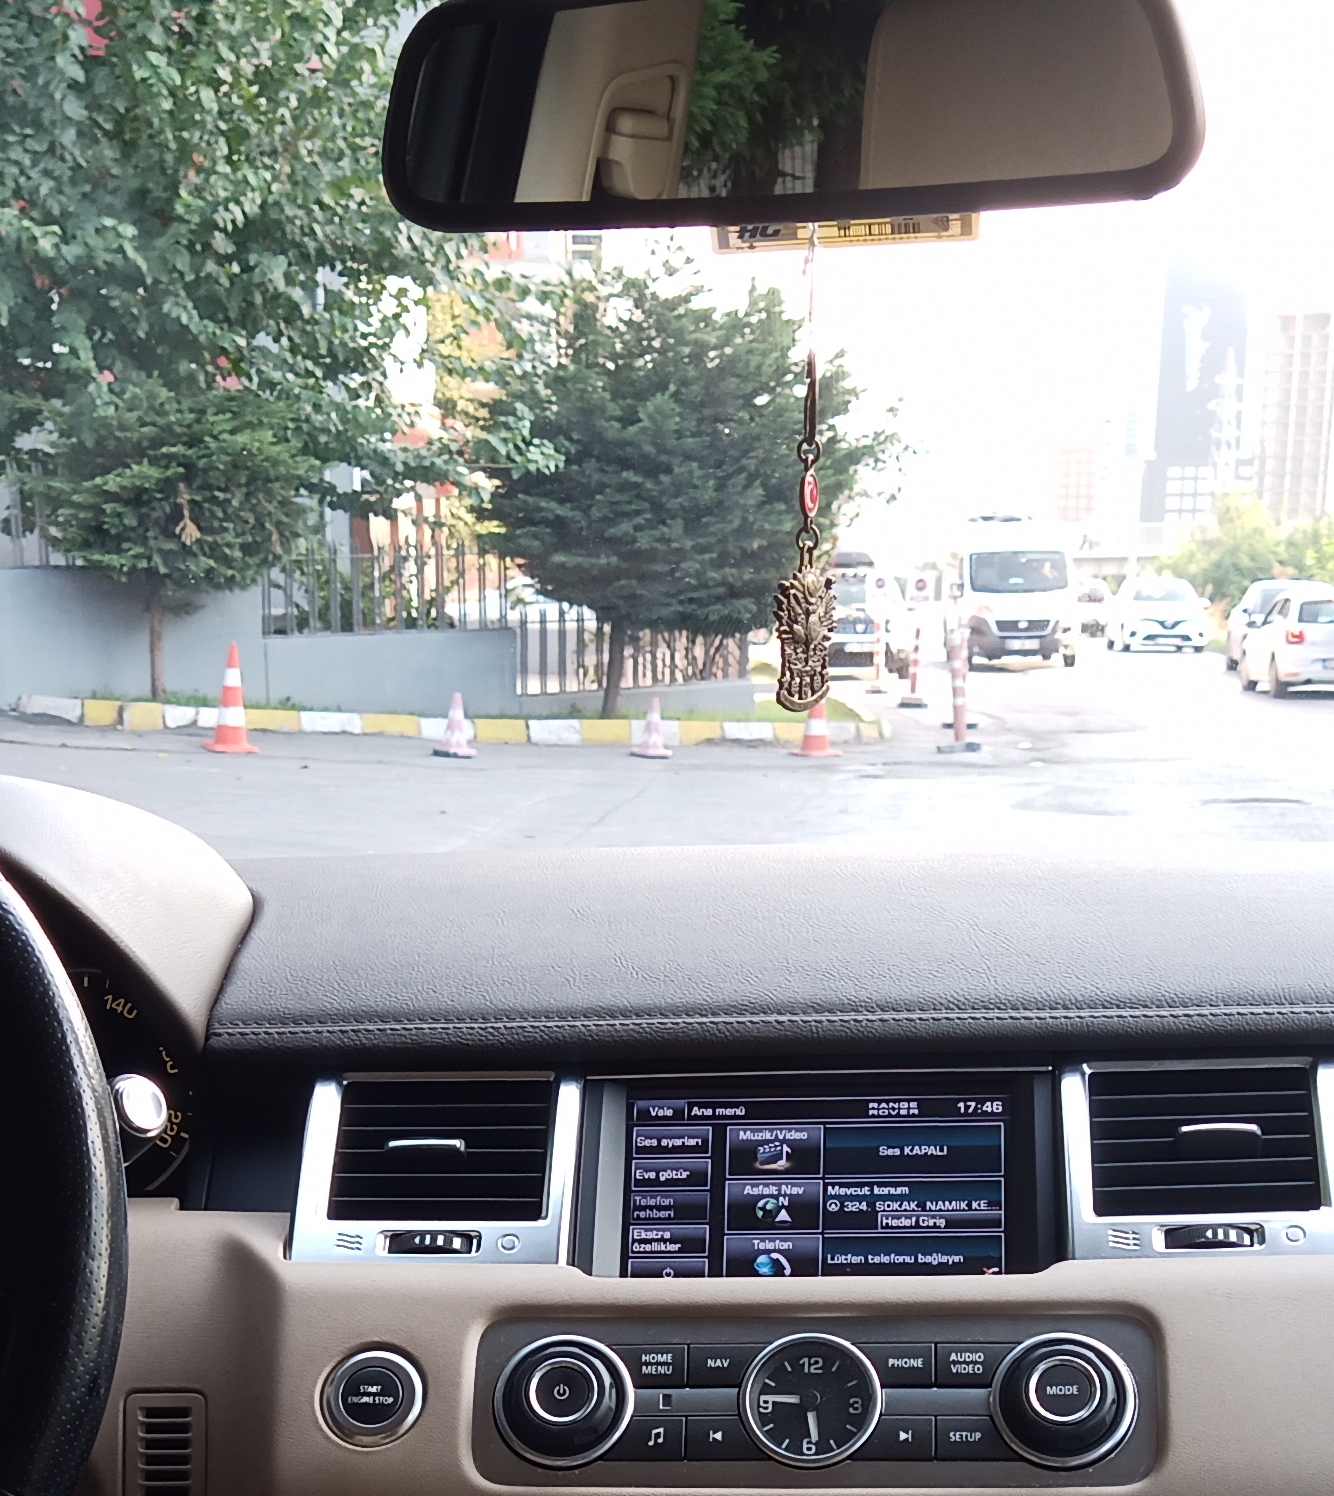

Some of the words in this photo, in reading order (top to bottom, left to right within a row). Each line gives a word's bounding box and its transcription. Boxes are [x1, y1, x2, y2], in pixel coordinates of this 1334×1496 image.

[649, 1107, 673, 1117] Vale
[691, 1106, 713, 1116] Ana
[716, 1105, 746, 1116] menü
[957, 1101, 1003, 1114] 17:46
[739, 1130, 808, 1141] Muzik/Video
[637, 1137, 658, 1147] Ses
[661, 1136, 702, 1148] ayarları
[879, 1146, 901, 1156] Ses
[904, 1145, 948, 1156] KAPALI
[636, 1169, 656, 1179] Eve
[659, 1168, 690, 1181] götür
[744, 1184, 778, 1196] Asfalt
[781, 1184, 805, 1195] Nav
[827, 1185, 871, 1196] Mevcut
[874, 1185, 909, 1195] konum
[634, 1196, 674, 1206] Telefon
[926, 1200, 969, 1211] NAMIK
[633, 1209, 674, 1219] rehberi
[882, 1216, 916, 1227] Hedef
[919, 1216, 946, 1228] Giriş
[633, 1230, 671, 1239] Ekstra
[632, 1241, 682, 1252] özellikler
[752, 1240, 793, 1250] Telefon
[827, 1253, 865, 1264] Lütfen
[868, 1253, 915, 1264] telefonu
[918, 1253, 964, 1266] bağlayın
[641, 1353, 673, 1363] HOME
[707, 1358, 730, 1368] NAV
[888, 1358, 924, 1368] PHONE
[949, 1352, 984, 1363] AUDIO
[641, 1365, 673, 1375] MENU
[799, 1357, 824, 1374] 12
[950, 1363, 983, 1374] VIDEO
[1046, 1385, 1079, 1395] MODE
[375, 1396, 394, 1404] STOP
[759, 1396, 773, 1413] 9
[849, 1398, 862, 1414] 3
[949, 1431, 982, 1442] SETUP
[802, 1438, 816, 1455] 6
